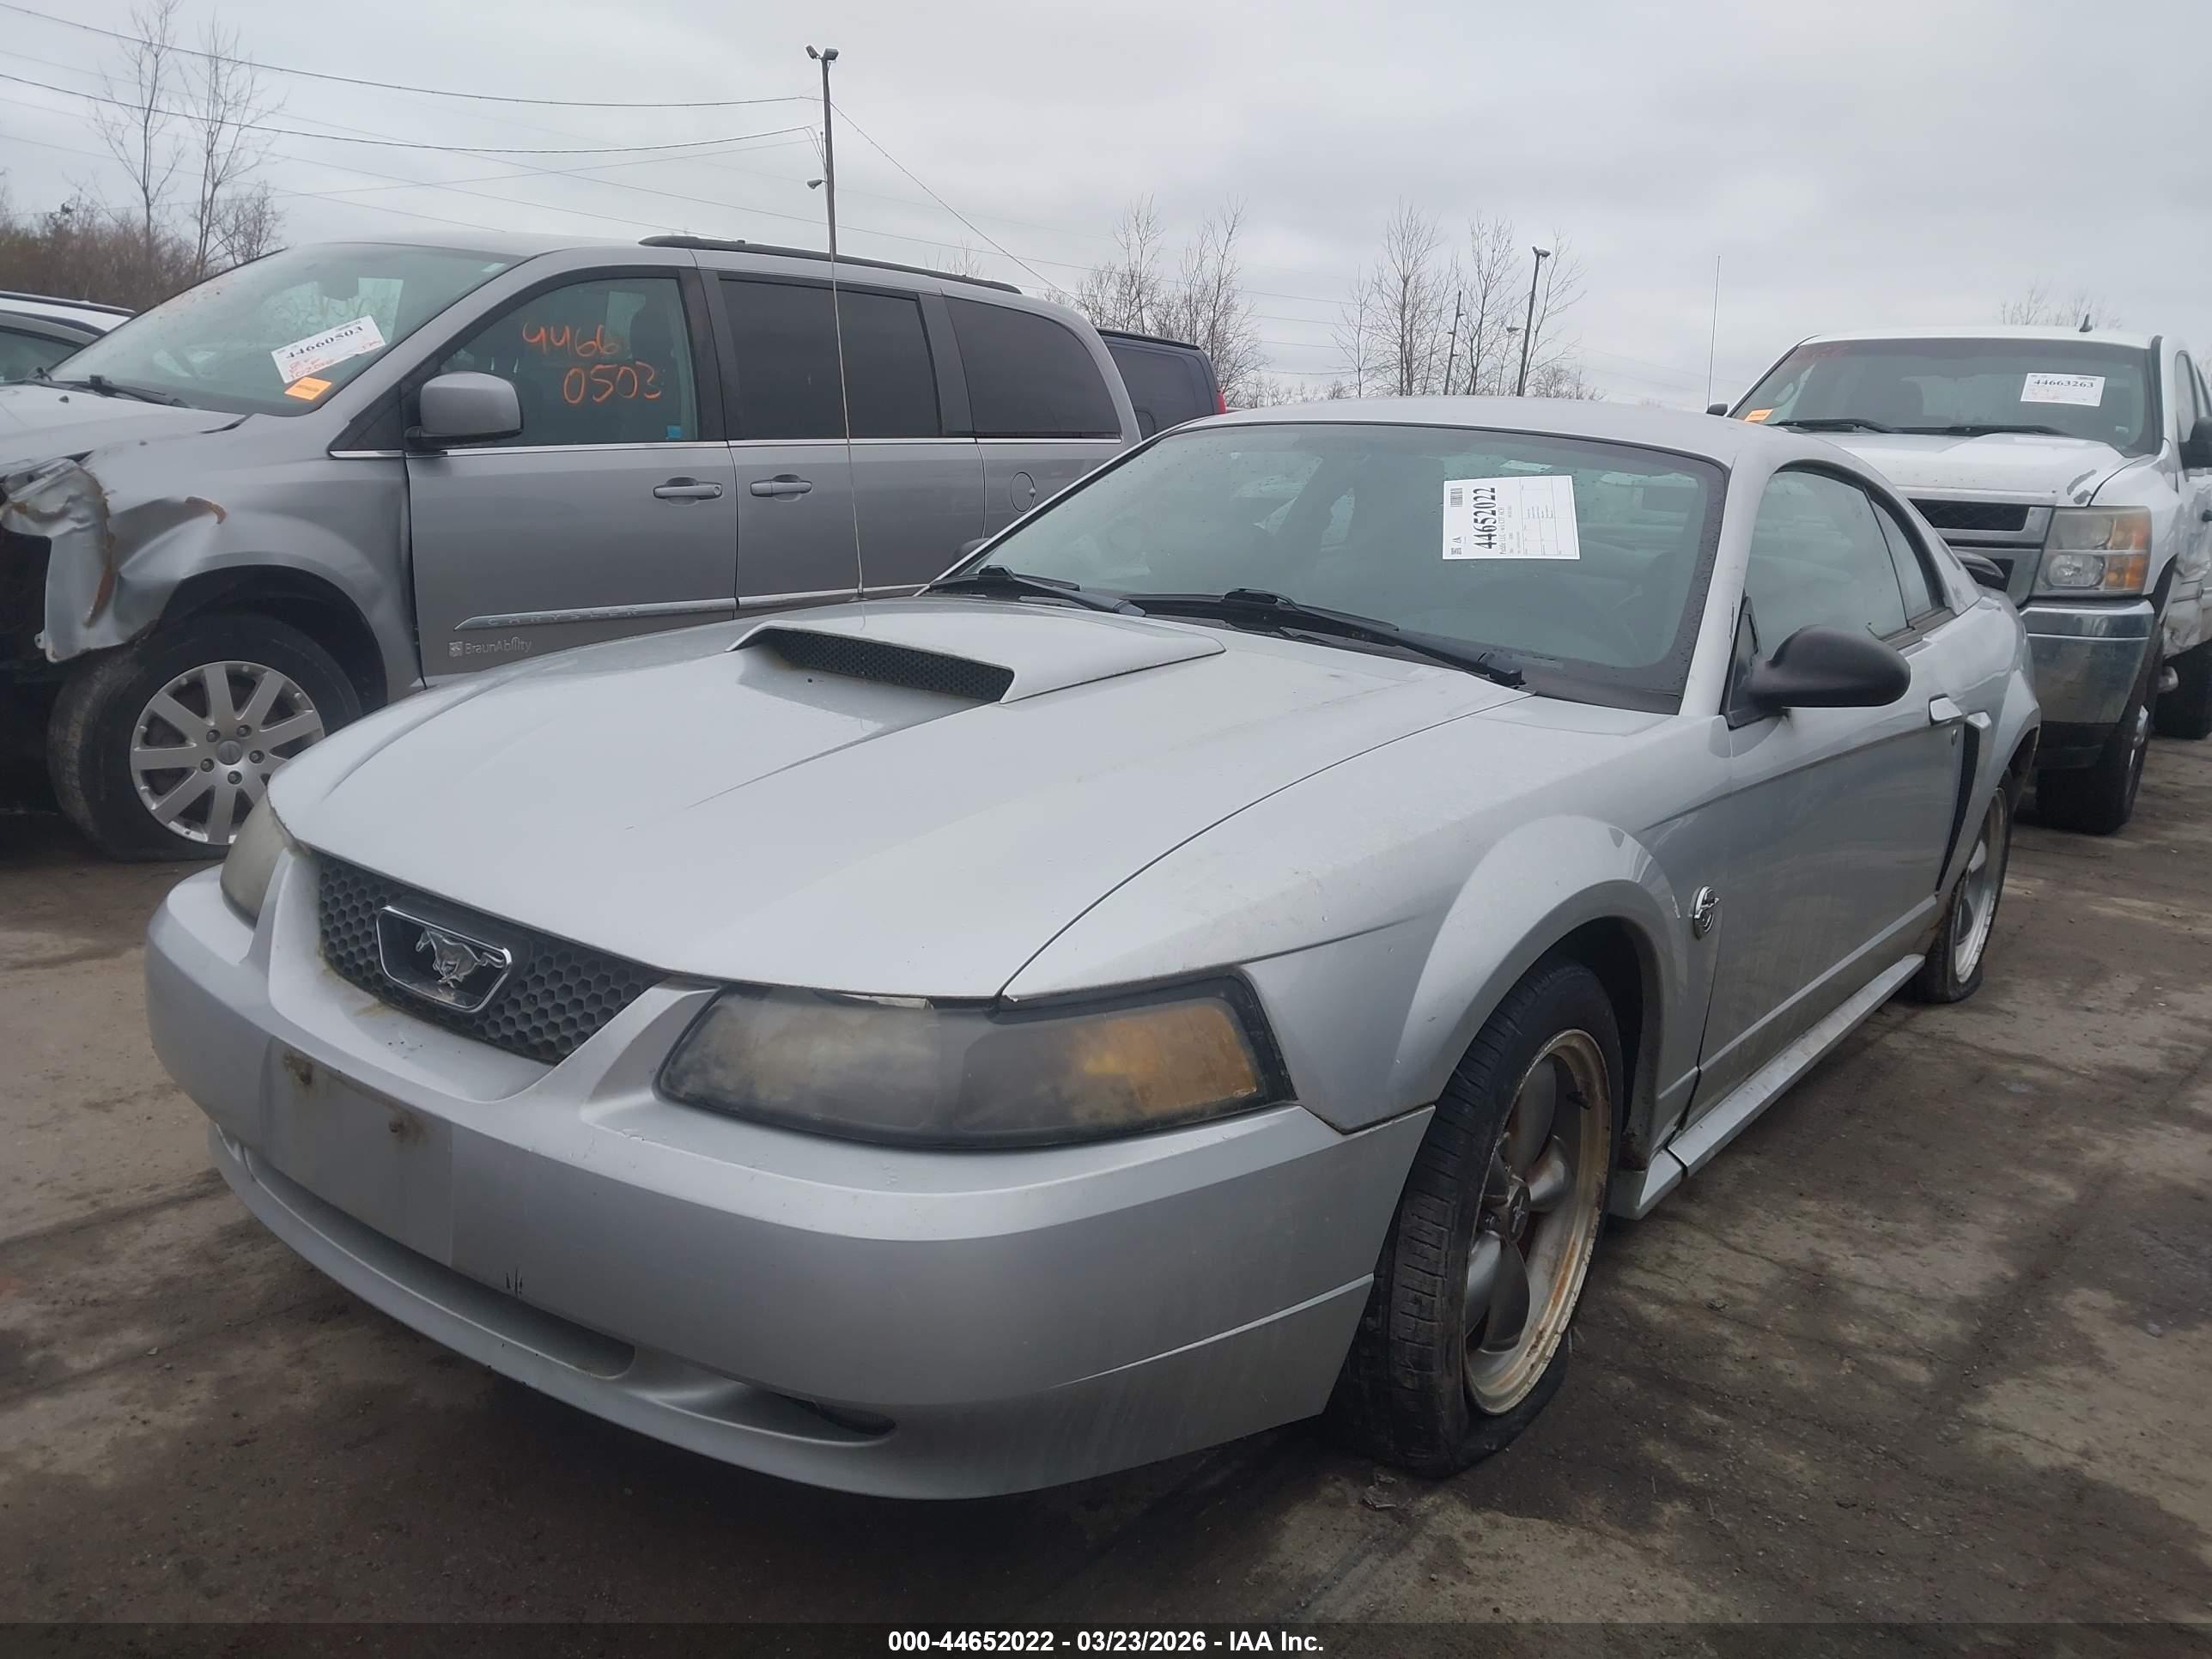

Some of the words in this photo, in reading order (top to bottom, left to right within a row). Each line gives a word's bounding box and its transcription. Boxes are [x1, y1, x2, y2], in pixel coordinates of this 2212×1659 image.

[522, 321, 621, 357] 4466
[563, 360, 661, 404] 0503
[2033, 378, 2094, 388] 44663263
[1473, 487, 1498, 550] 44652022
[487, 607, 641, 625] CHRYSLER
[465, 636, 532, 655] BraunAbility
